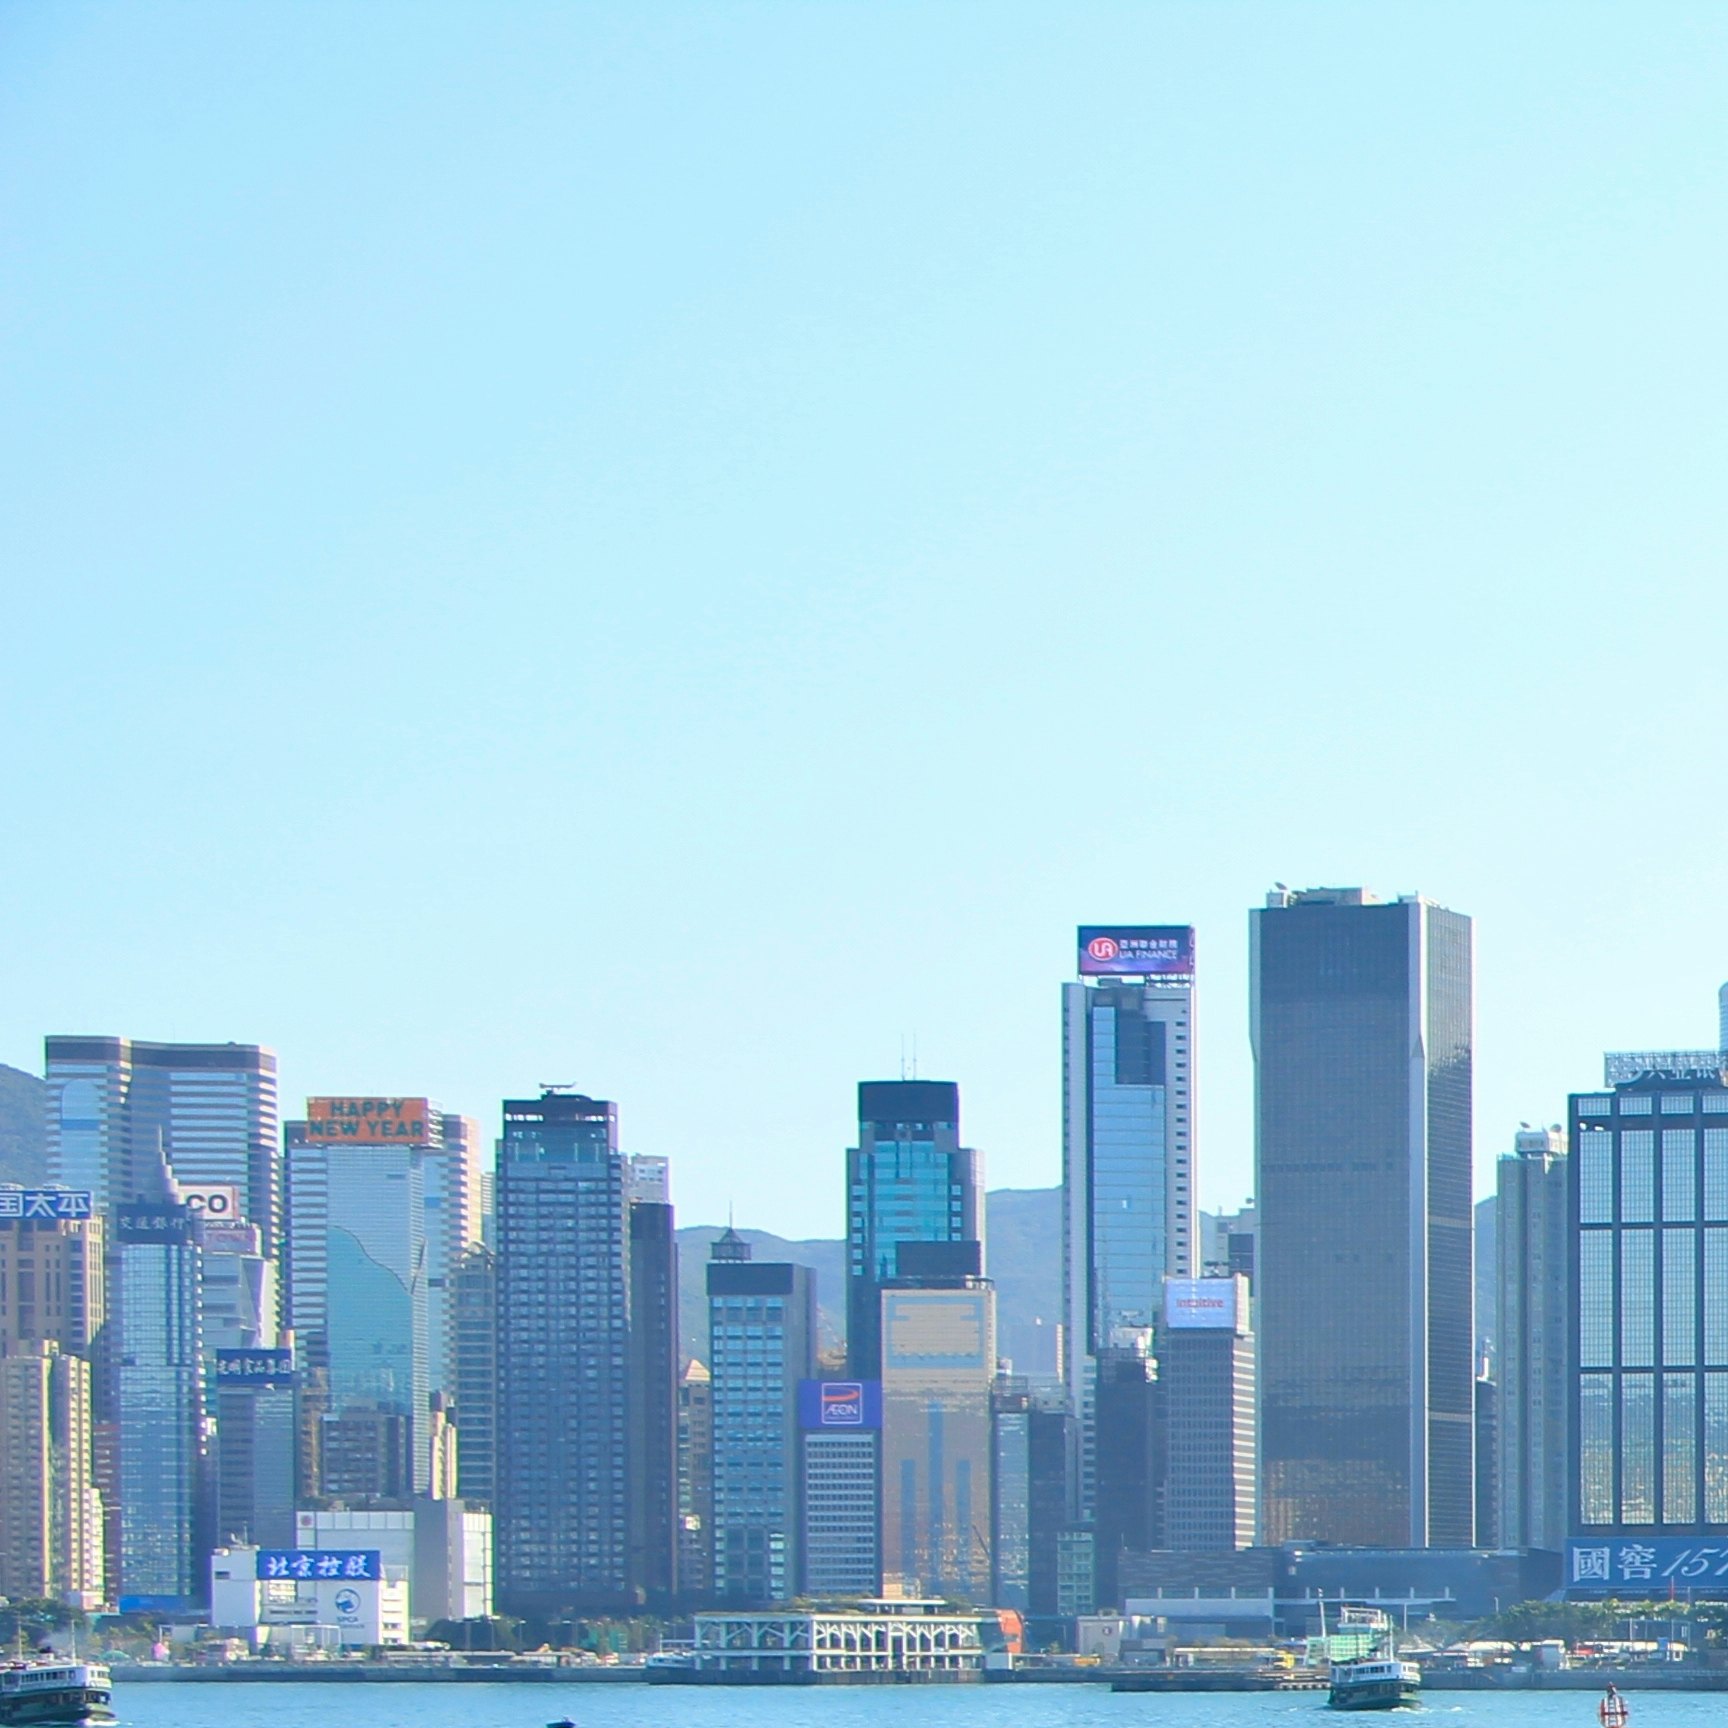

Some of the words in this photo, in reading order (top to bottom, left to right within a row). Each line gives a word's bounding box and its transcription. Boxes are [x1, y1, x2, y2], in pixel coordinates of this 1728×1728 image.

[330, 1100, 403, 1117] HAPPY
[309, 1120, 358, 1136] NEW
[366, 1120, 423, 1136] YEAR
